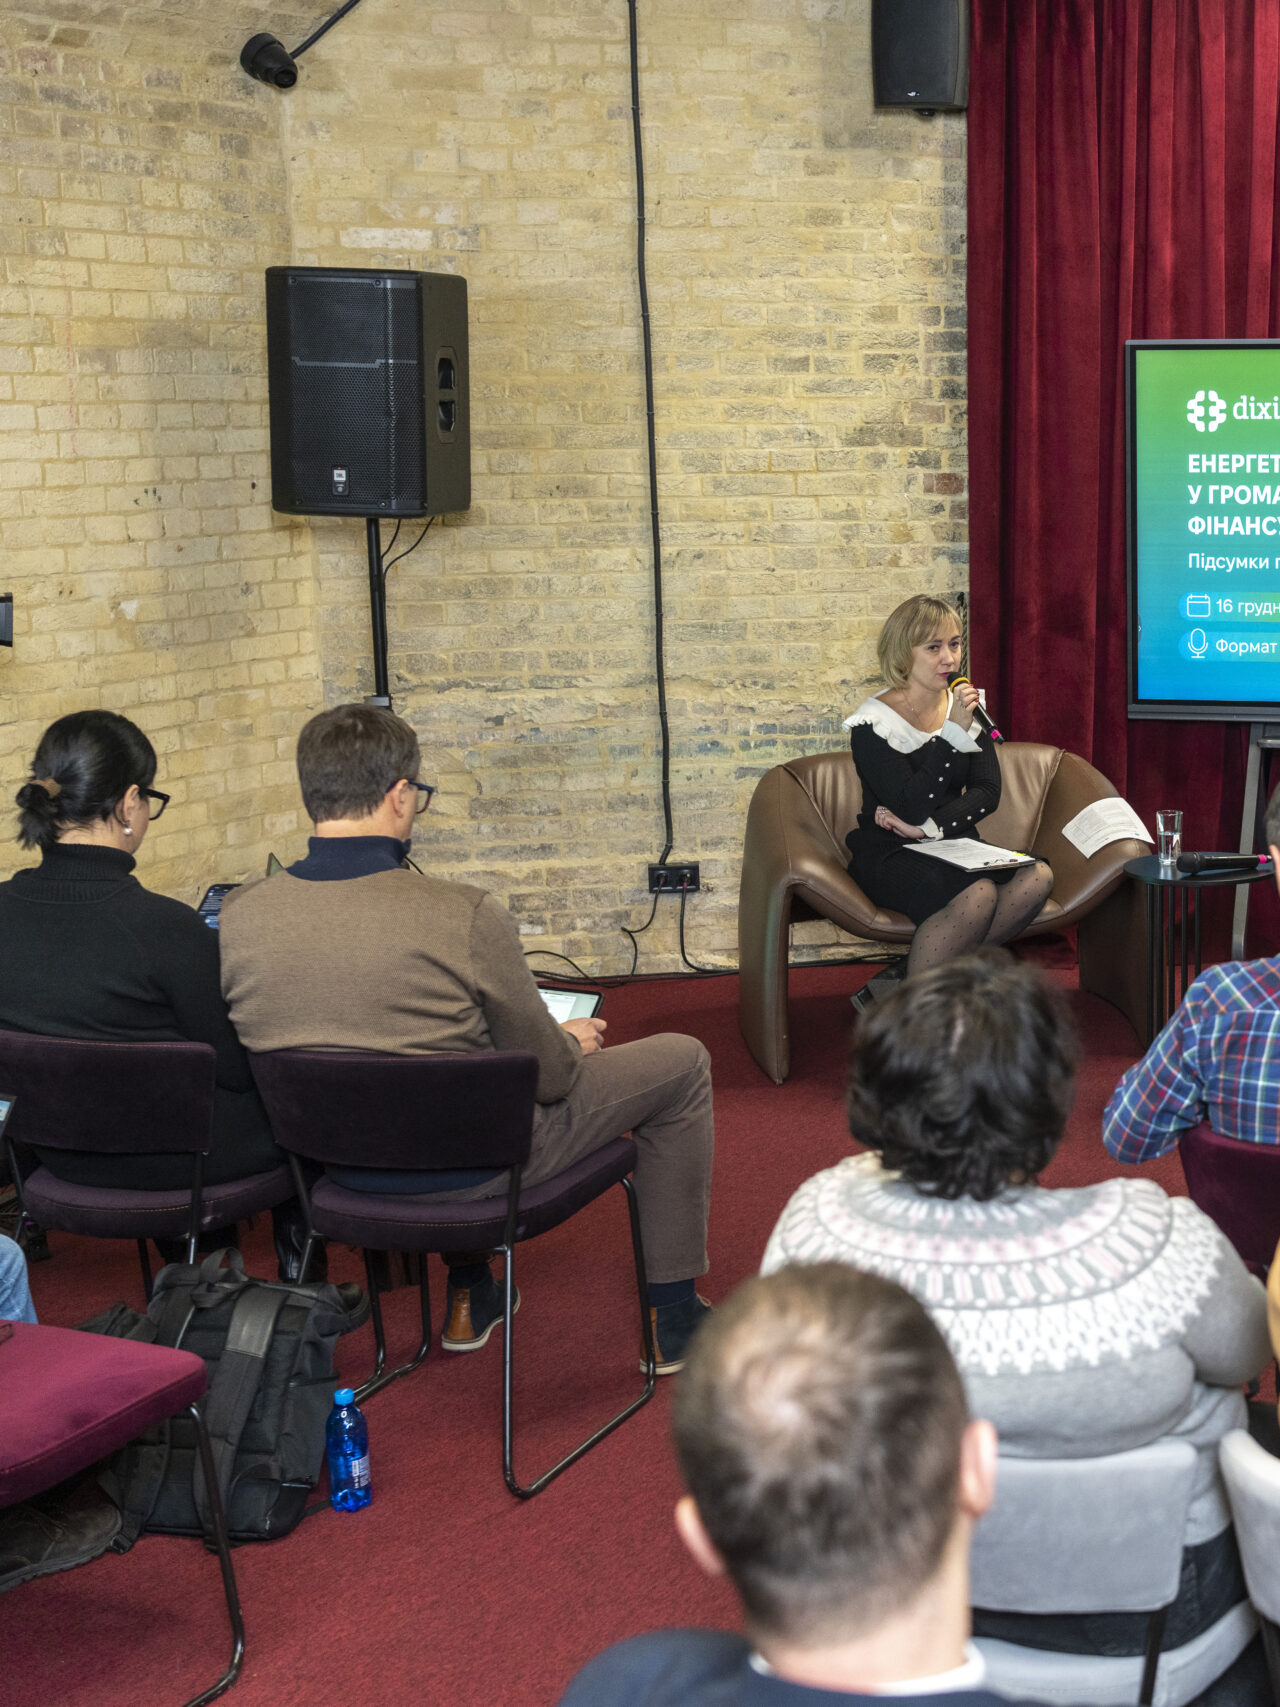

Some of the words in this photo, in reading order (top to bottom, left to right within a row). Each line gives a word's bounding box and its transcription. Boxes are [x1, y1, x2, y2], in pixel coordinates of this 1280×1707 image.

[1187, 485, 1202, 505] У
[1188, 553, 1270, 572] Підсумки
[1215, 599, 1233, 613] 16
[1215, 638, 1278, 656] Формат
